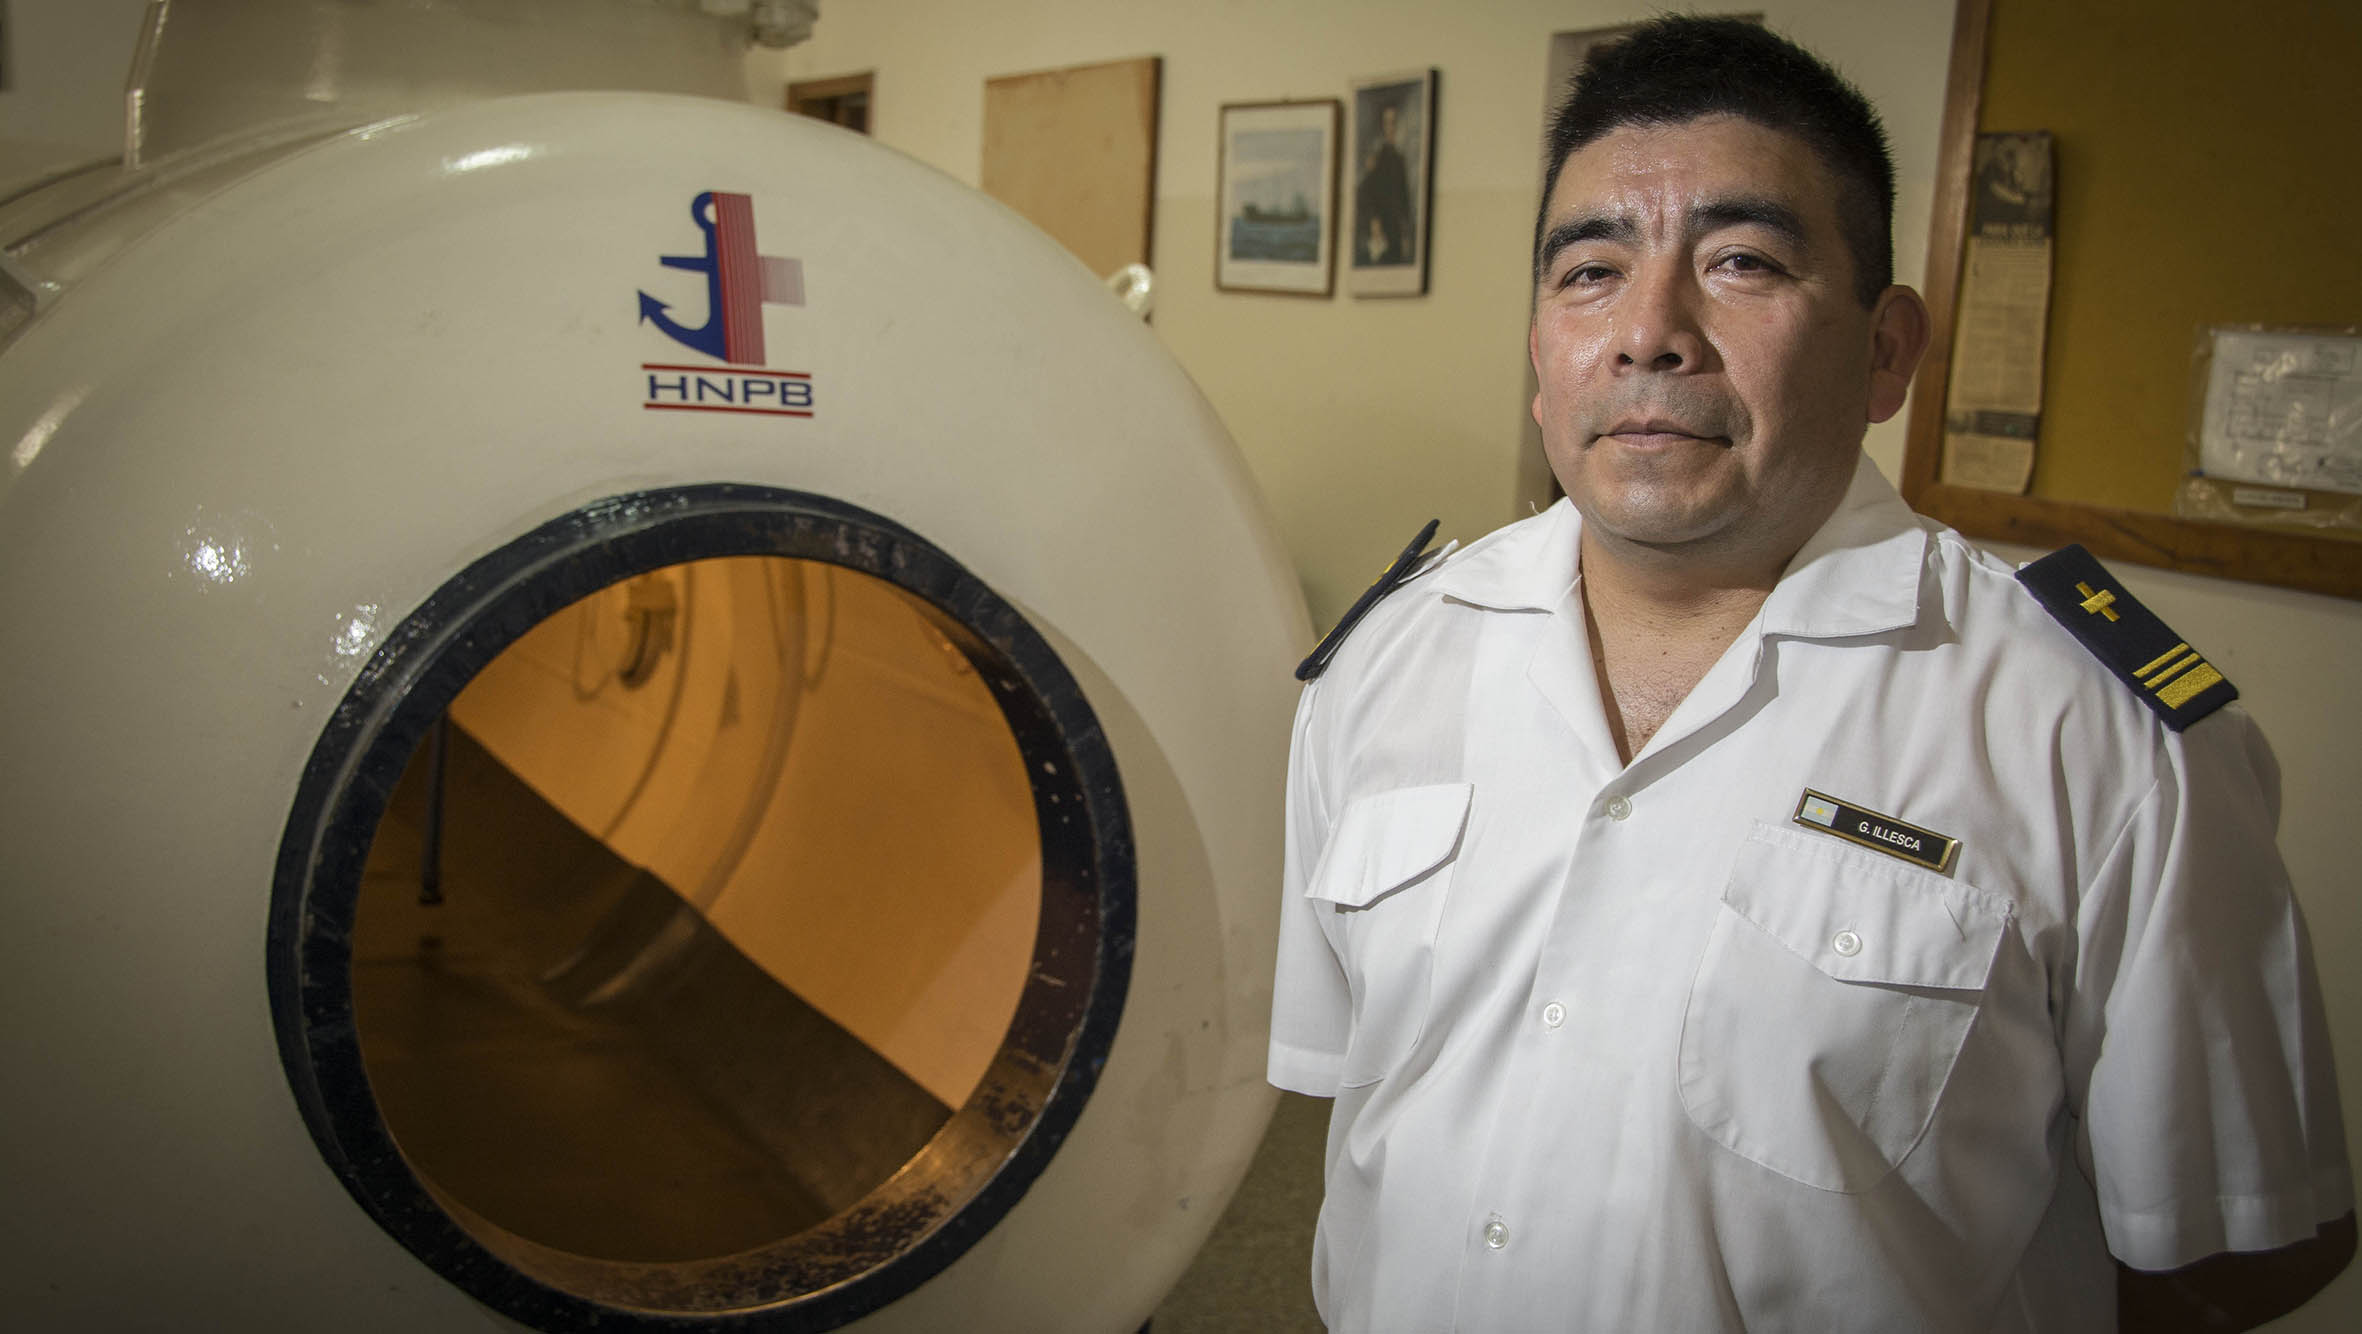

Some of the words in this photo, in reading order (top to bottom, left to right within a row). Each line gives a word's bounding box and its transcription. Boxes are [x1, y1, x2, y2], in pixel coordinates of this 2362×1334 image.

[649, 374, 813, 407] HNPB
[1859, 821, 1870, 834] G.
[1872, 825, 1920, 851] ILLESCA
